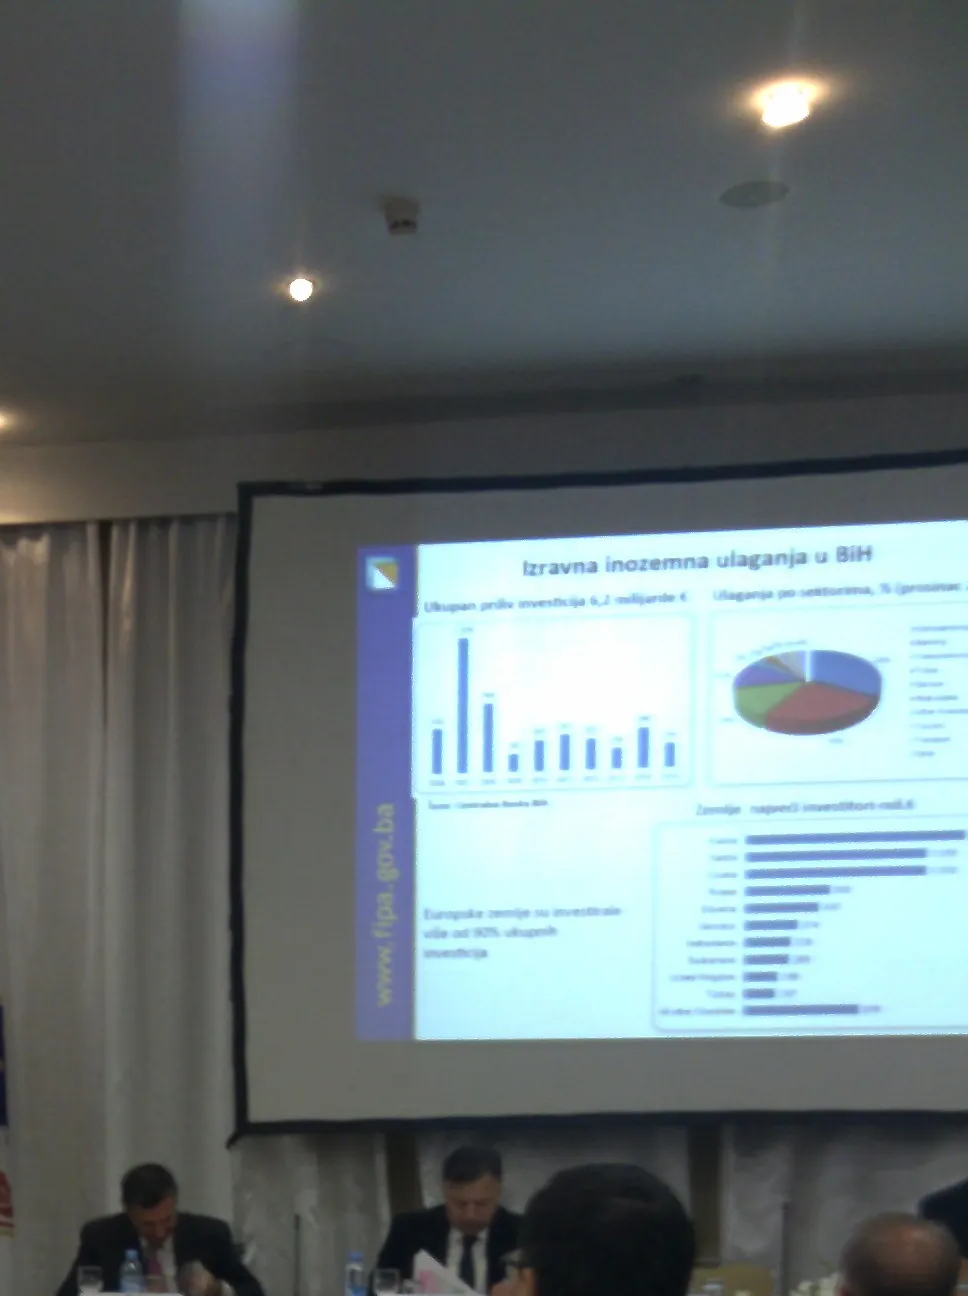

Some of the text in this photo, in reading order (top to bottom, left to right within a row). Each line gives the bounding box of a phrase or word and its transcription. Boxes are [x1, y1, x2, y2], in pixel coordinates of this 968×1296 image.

[522, 544, 873, 577] Izravna inozemna ulaganja u BiH
[518, 596, 586, 610] investicija
[372, 803, 400, 1007] www.fipa.gov.ba
